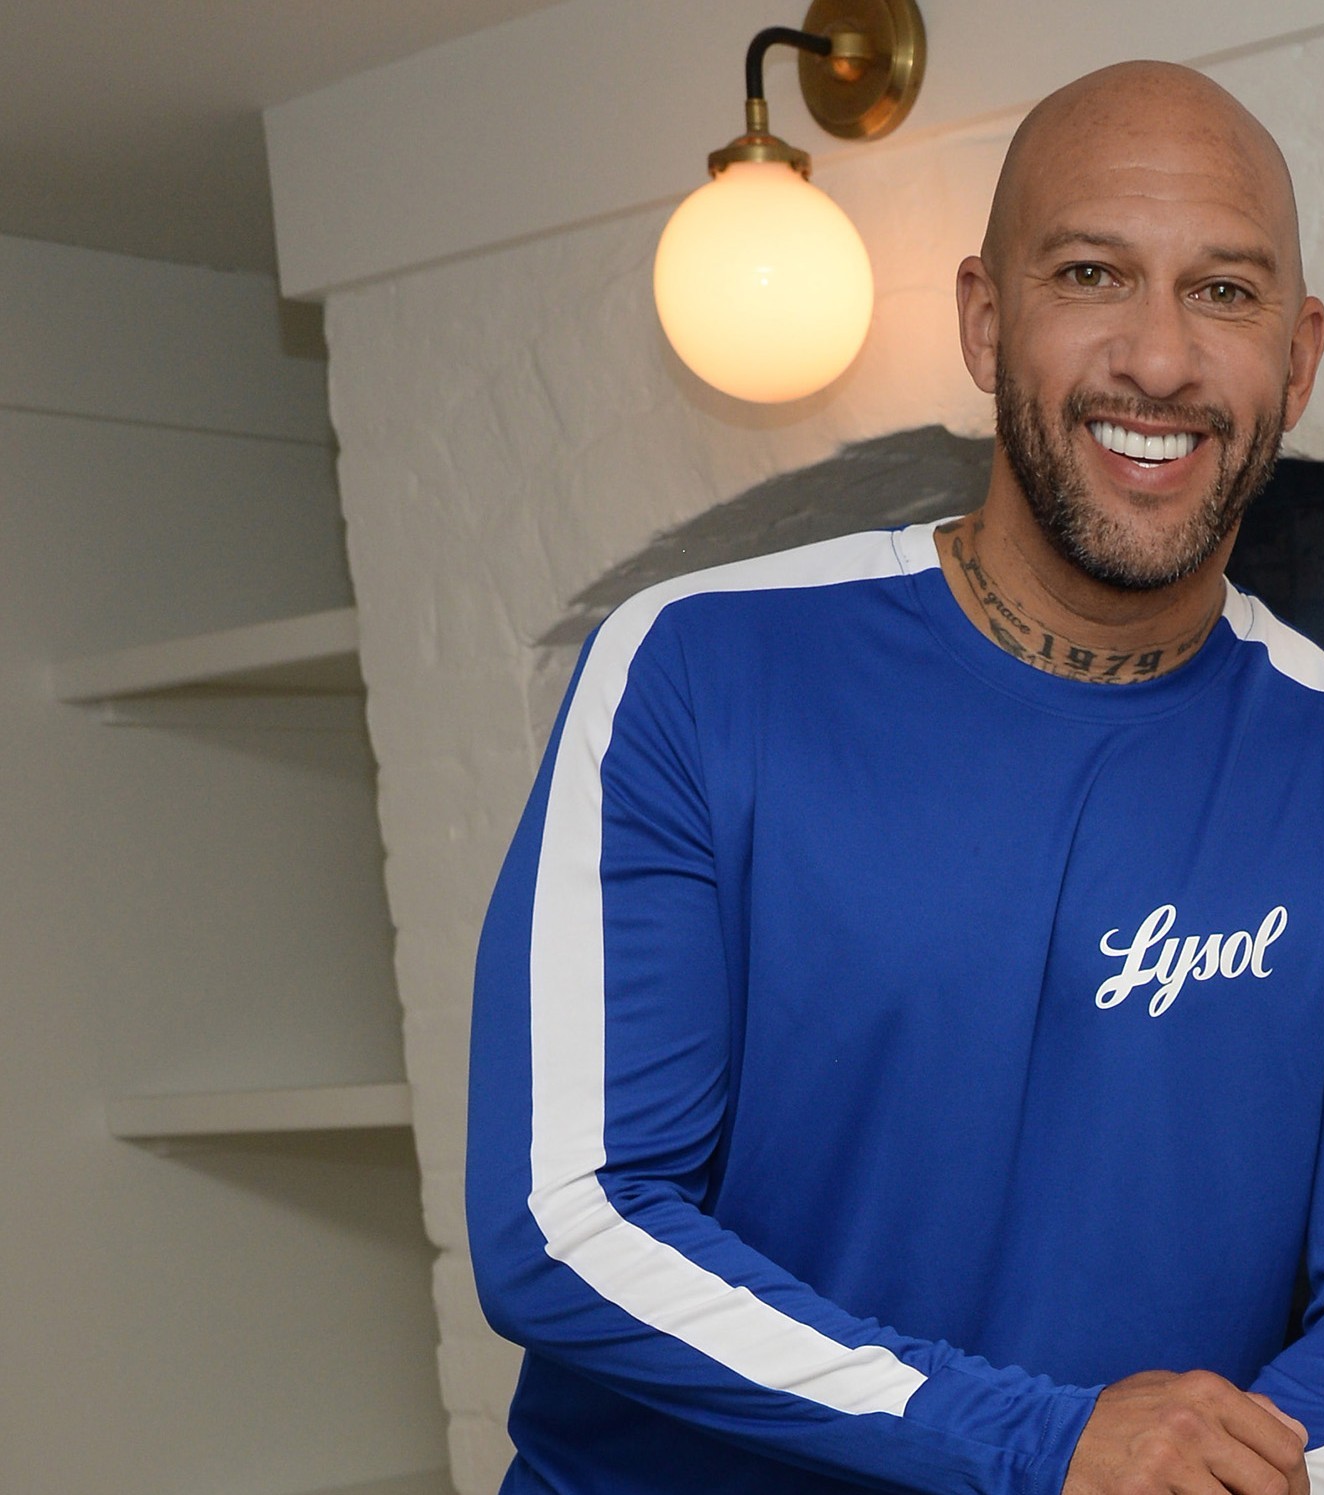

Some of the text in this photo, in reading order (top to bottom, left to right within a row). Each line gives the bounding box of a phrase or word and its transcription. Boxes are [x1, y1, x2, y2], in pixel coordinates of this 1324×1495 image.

[983, 592, 1031, 634] grace
[1036, 633, 1165, 677] 1979
[1095, 904, 1288, 1018] Lysol
